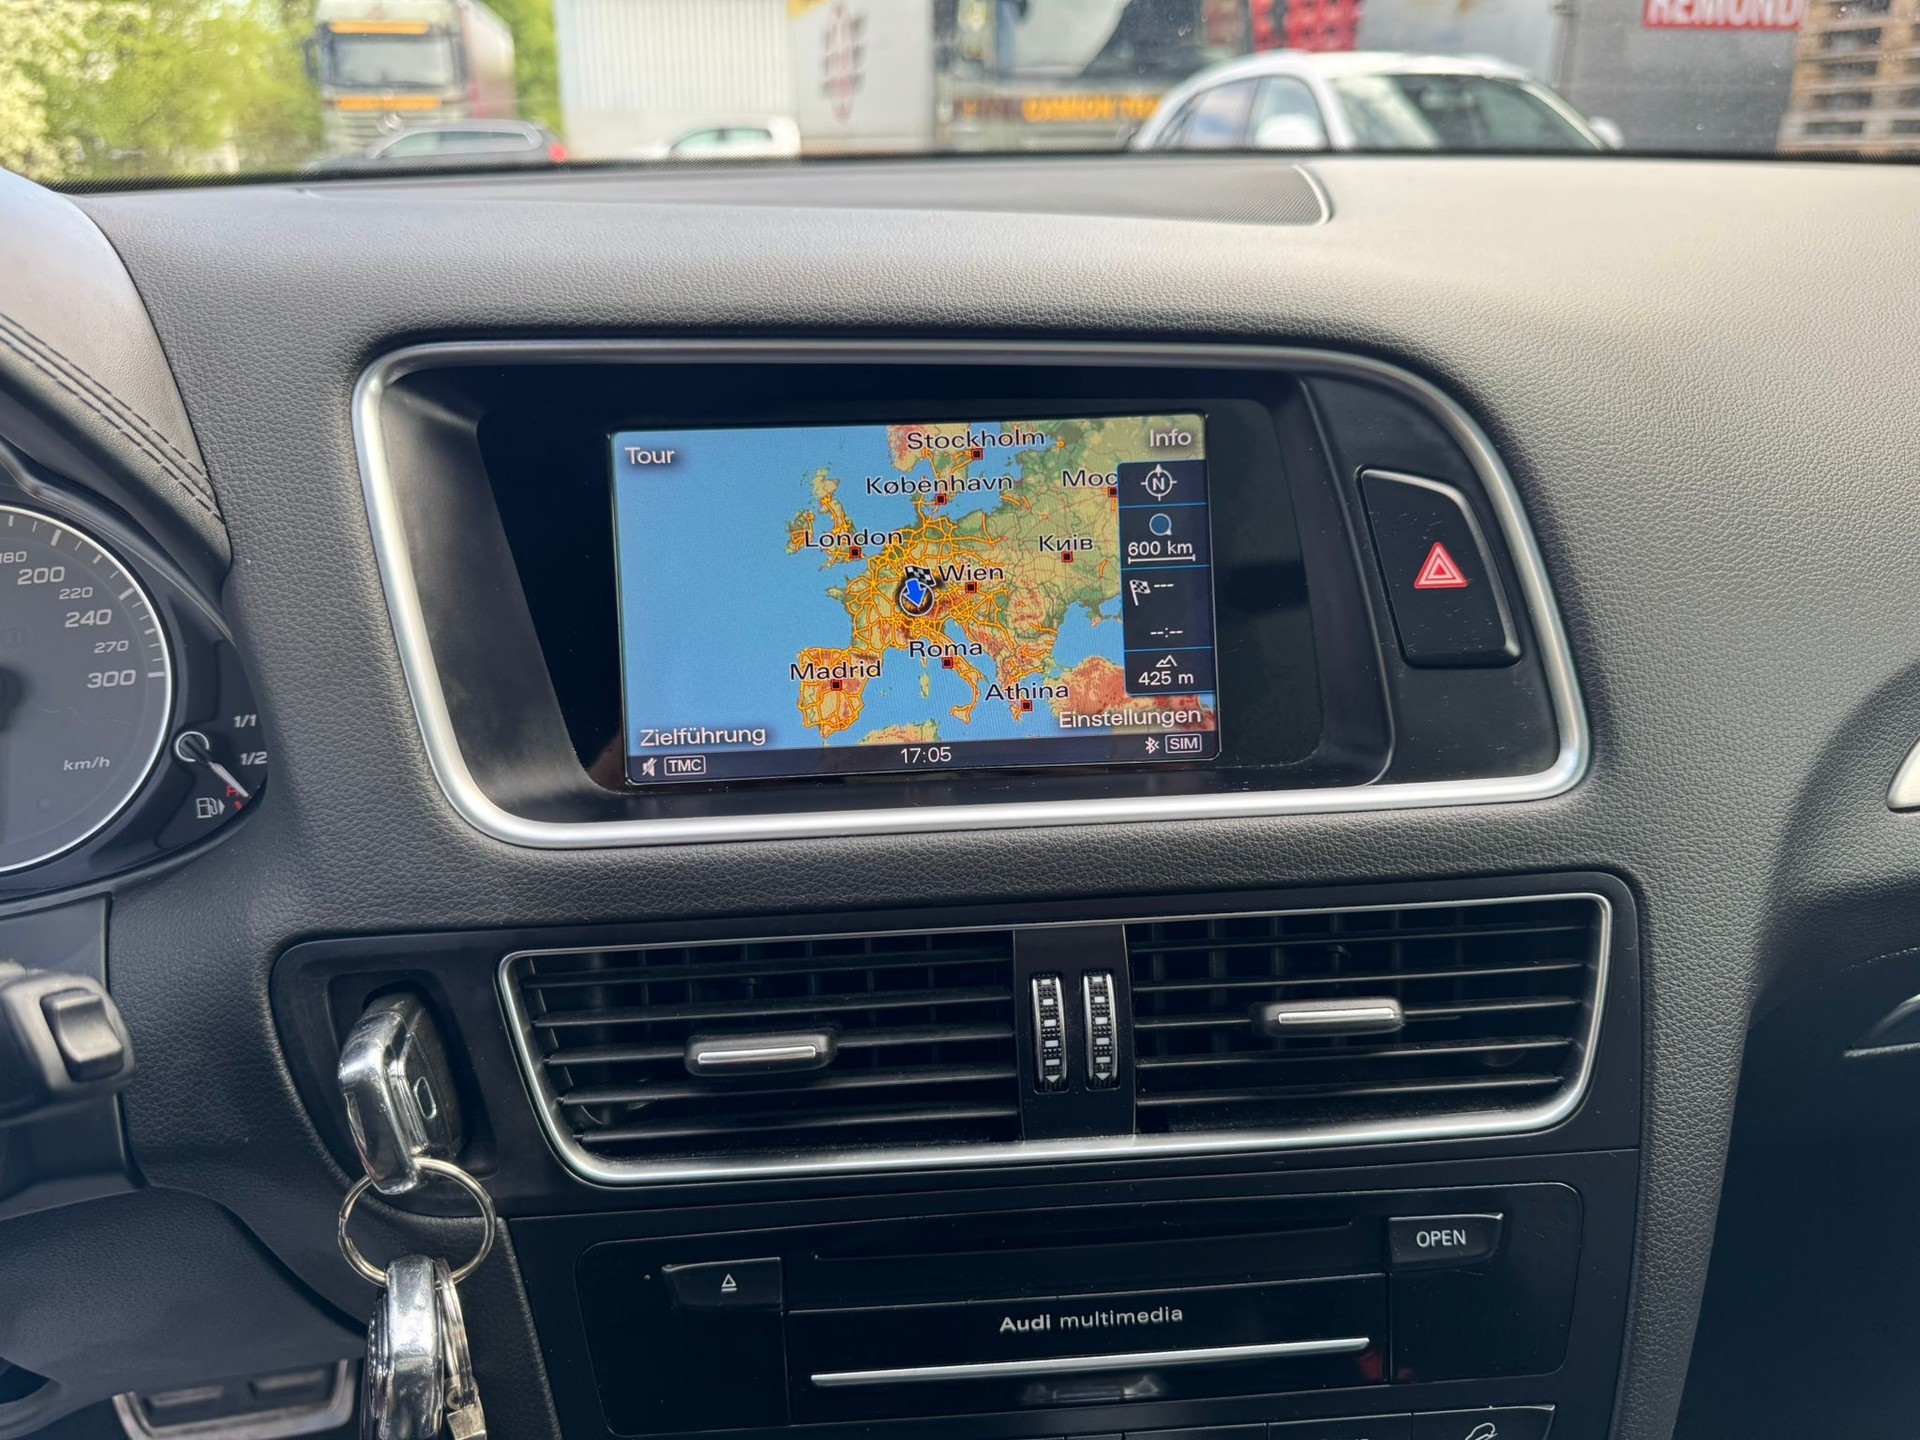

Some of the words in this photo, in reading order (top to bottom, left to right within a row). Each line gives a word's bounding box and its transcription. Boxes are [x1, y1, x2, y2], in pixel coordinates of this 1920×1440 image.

[906, 429, 1046, 451] Stockholm
[1149, 429, 1192, 447] Info
[625, 446, 675, 465] Tour
[866, 475, 1013, 494] København
[805, 528, 903, 549] London
[1127, 540, 1162, 557] 600
[1167, 539, 1193, 556] km
[17, 566, 65, 585] 200
[939, 563, 1004, 583] Wien
[58, 586, 93, 600] 220
[64, 608, 112, 628] 240
[94, 640, 129, 653] 270
[909, 640, 983, 659] Roma
[87, 669, 136, 689] 300
[790, 660, 882, 681] Madrid
[1138, 669, 1172, 687] 425
[1178, 672, 1194, 685] m
[985, 682, 1069, 702] Athina
[233, 714, 257, 727] 1/1
[1059, 708, 1201, 729] Einstellungen
[640, 727, 766, 747] Zielführung
[1169, 736, 1200, 751] SIM
[64, 757, 110, 770] km/h
[240, 751, 268, 766] 1/2
[900, 746, 952, 764] 17:05
[668, 758, 702, 773] TMC
[1415, 1230, 1468, 1249] OPEN
[999, 1314, 1051, 1335] Audi
[1058, 1306, 1186, 1331] multimedia
